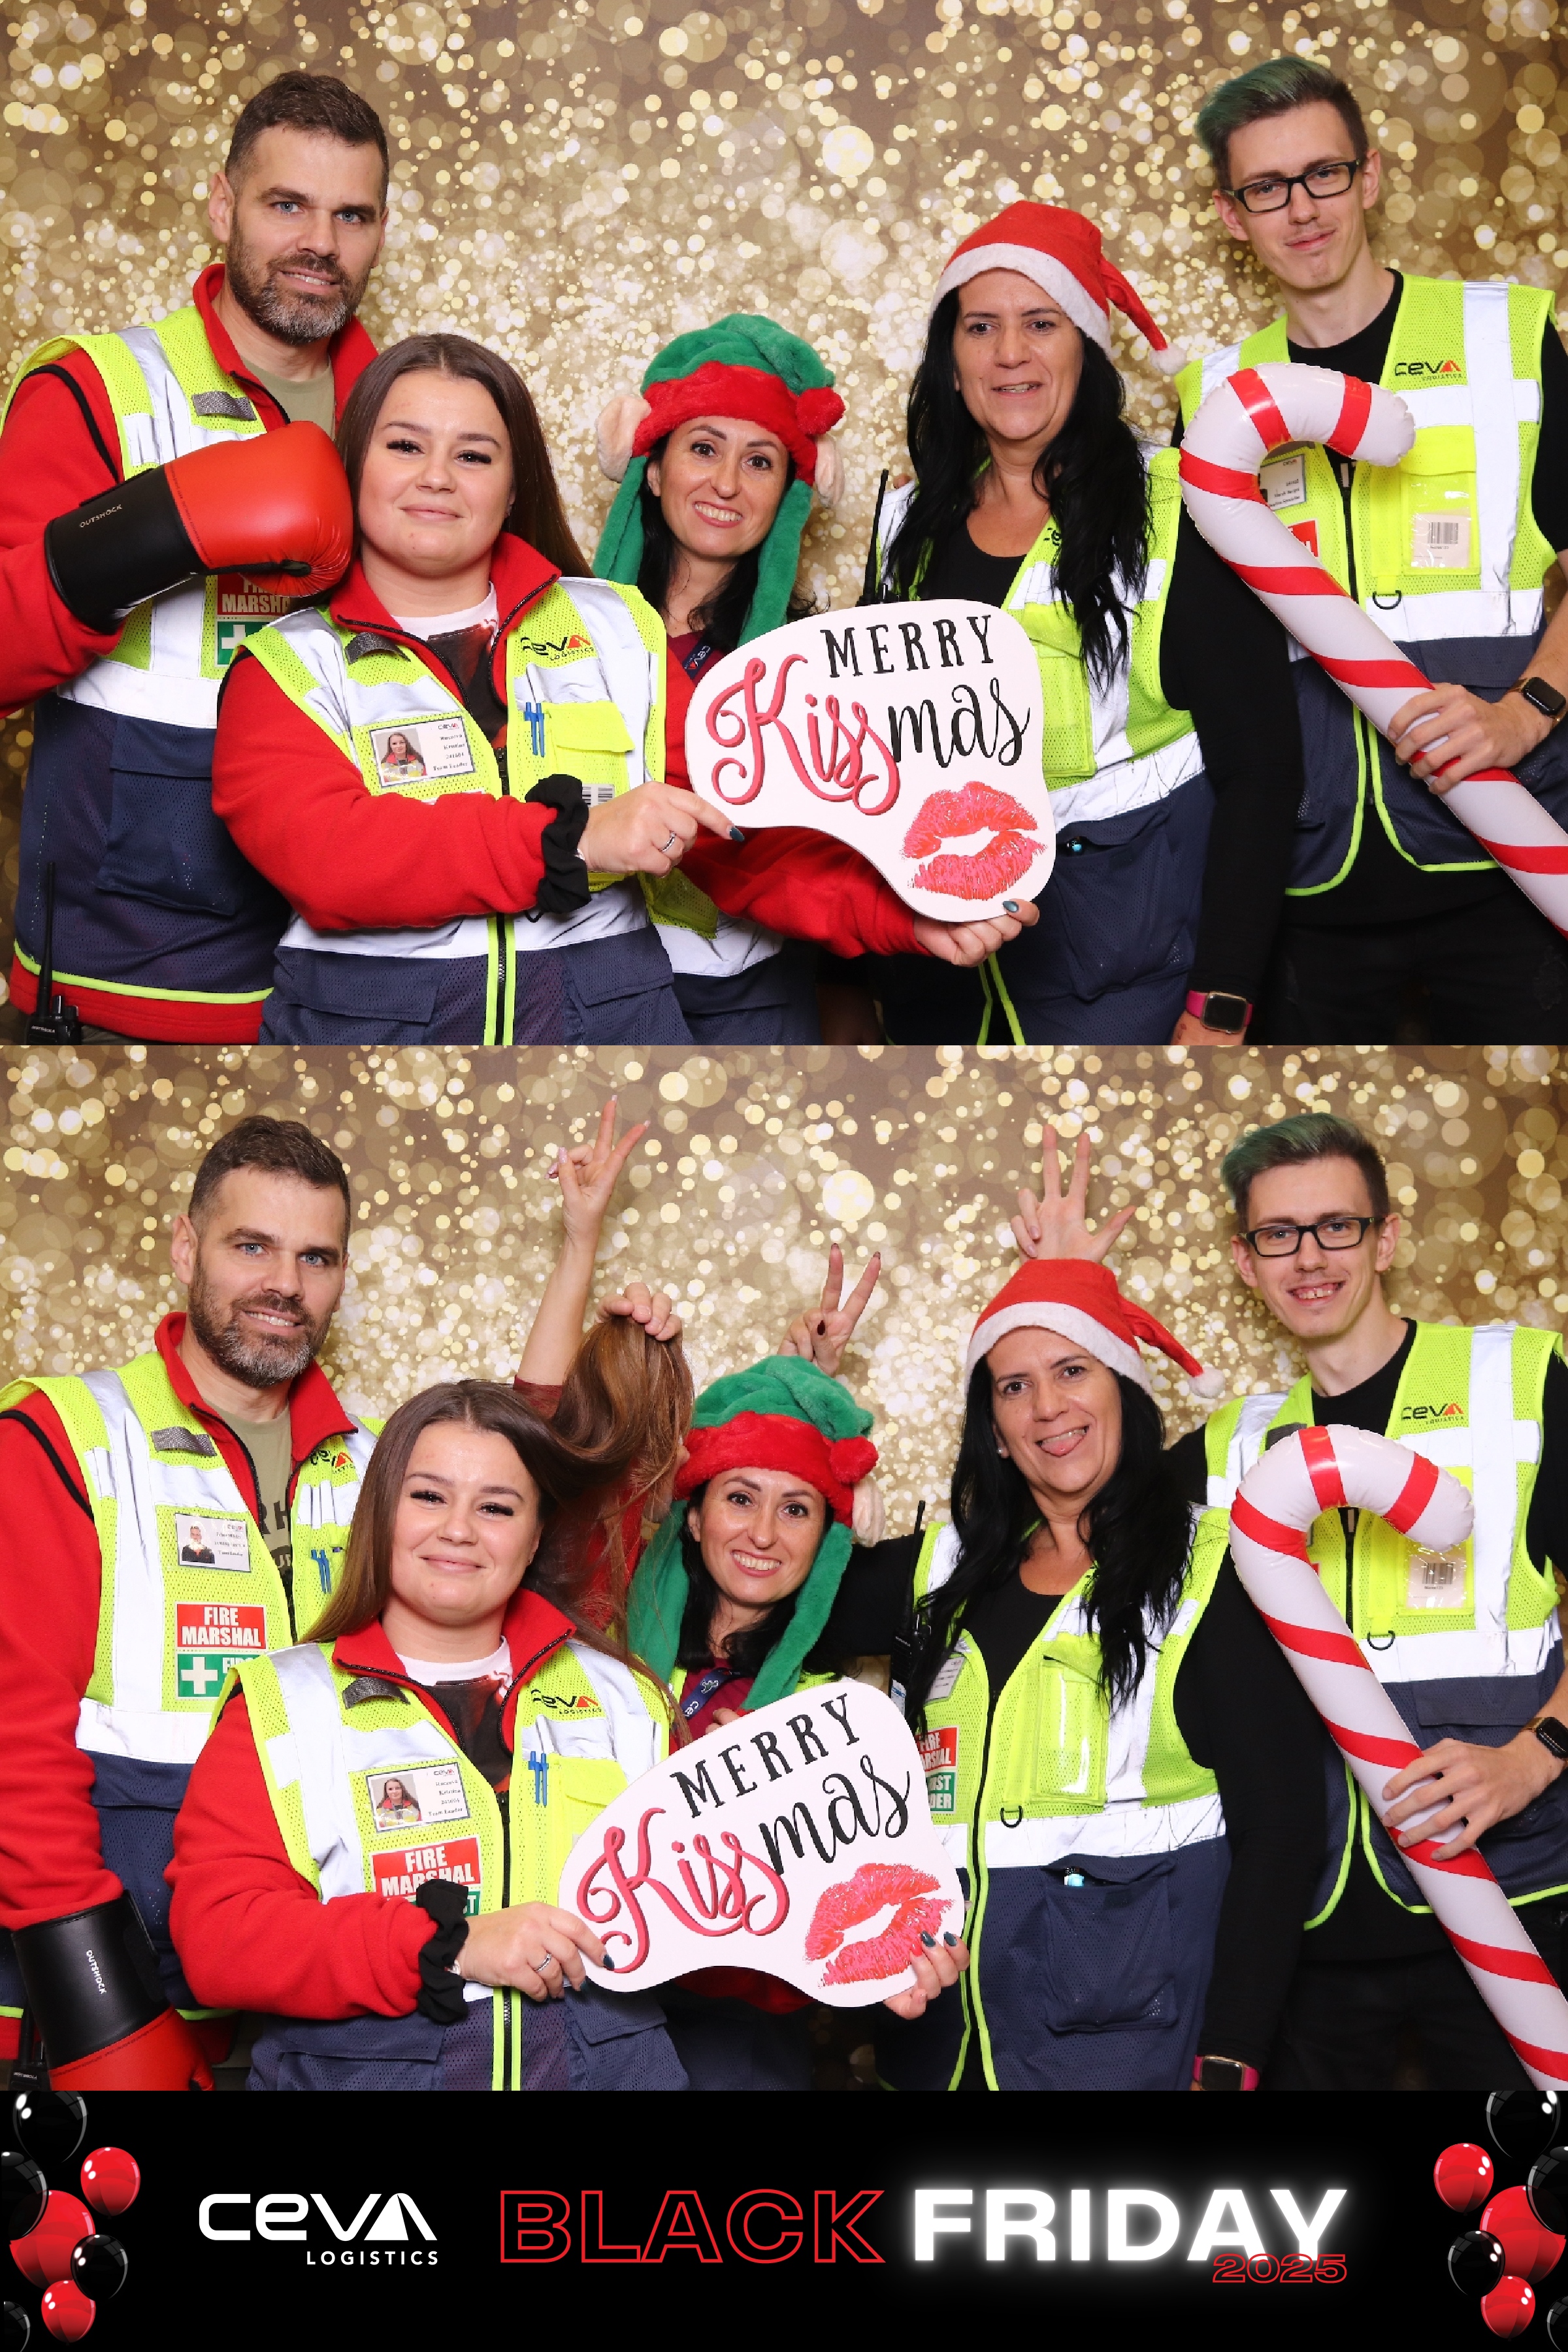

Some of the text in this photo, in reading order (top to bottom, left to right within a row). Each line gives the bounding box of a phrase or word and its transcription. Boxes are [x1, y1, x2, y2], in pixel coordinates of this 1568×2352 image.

[79, 504, 123, 528] OUTSHOCK
[222, 594, 291, 613] MARSHA
[820, 615, 994, 678] MERRY
[204, 1607, 239, 1626] FIRE
[182, 1625, 261, 1646] MARSHAL
[670, 1693, 860, 1819] MERRY
[405, 1846, 448, 1873] FIRE
[86, 1950, 107, 1995] OUTSHOCK
